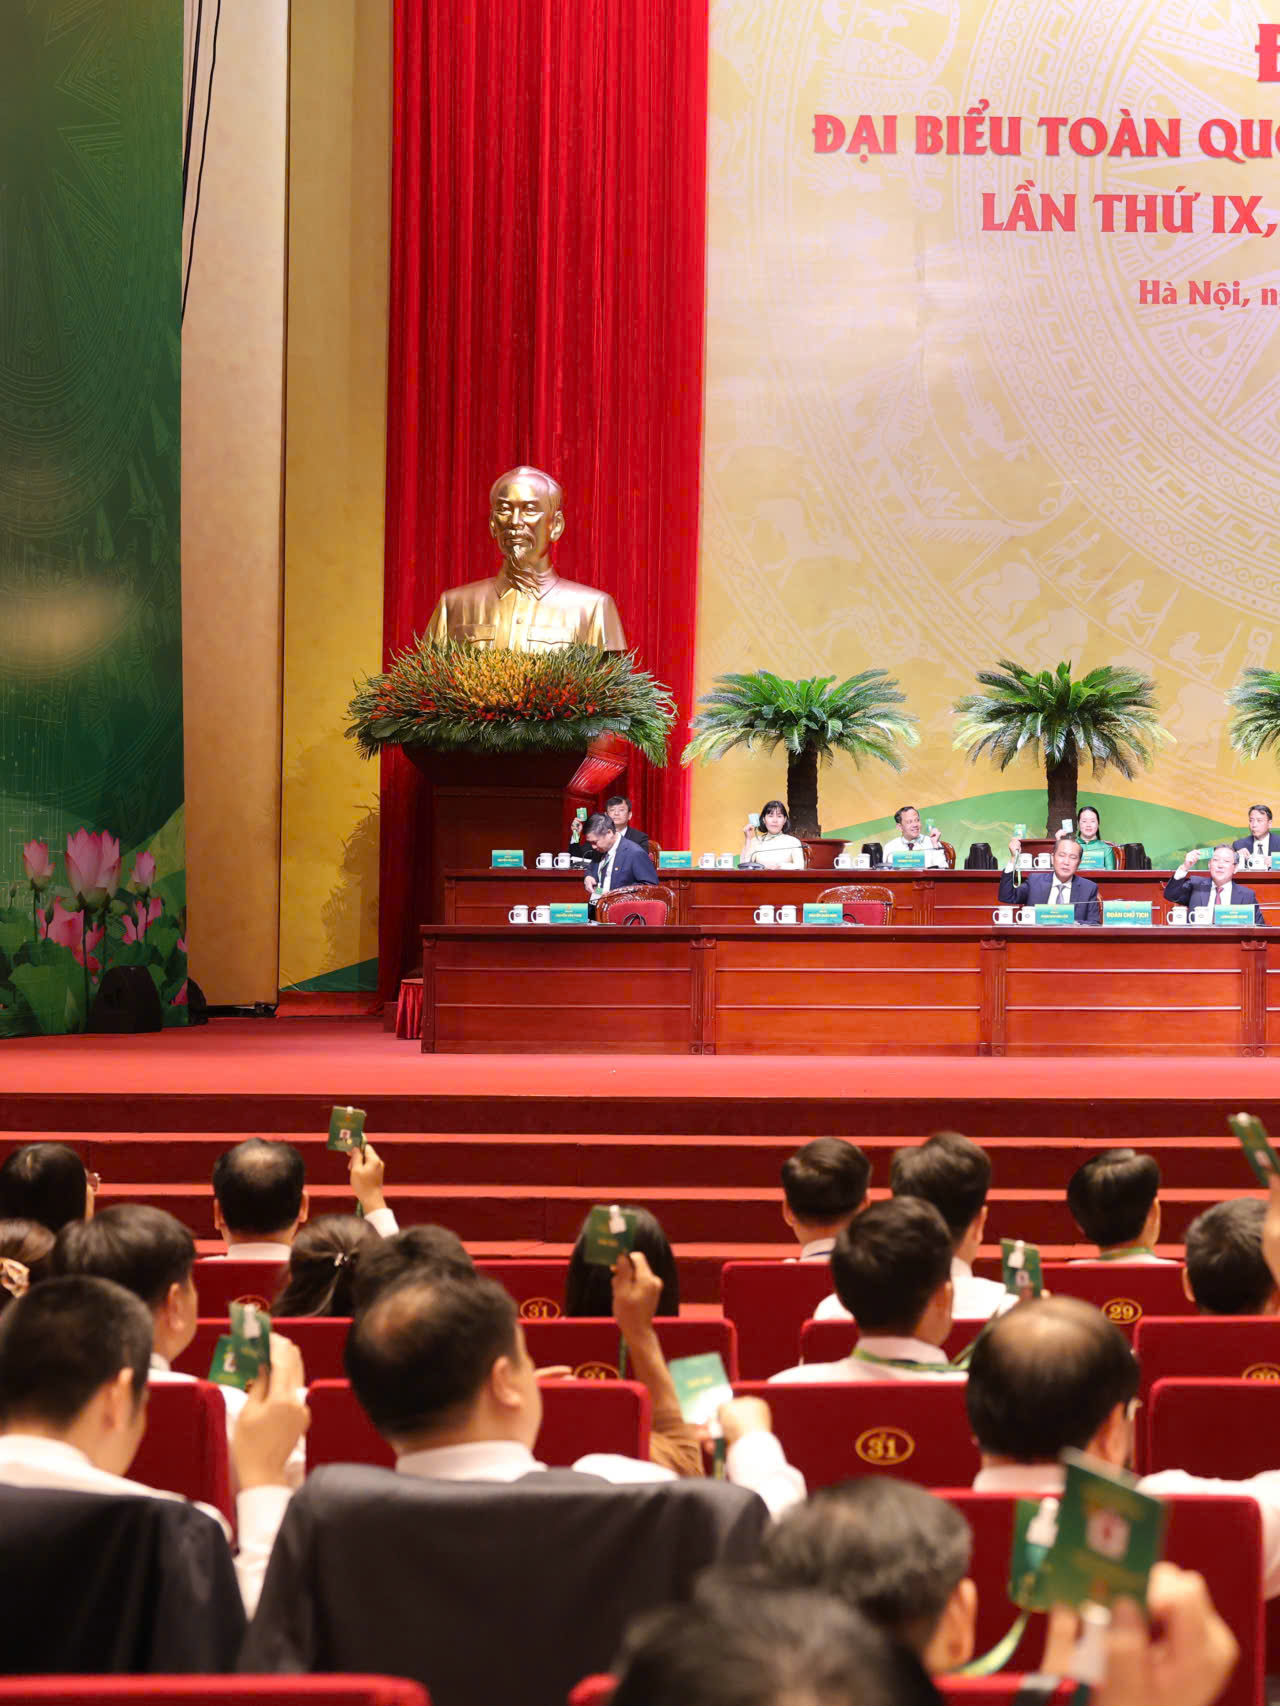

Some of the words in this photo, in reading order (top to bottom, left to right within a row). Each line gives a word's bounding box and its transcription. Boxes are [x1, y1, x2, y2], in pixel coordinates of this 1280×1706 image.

[812, 113, 898, 163] ĐẠI
[914, 98, 1023, 156] BIỂU
[1036, 109, 1182, 158] TOÀN
[981, 179, 1077, 232] LẦN
[1093, 185, 1202, 234] THỨ
[1213, 195, 1279, 239] IX,
[1139, 279, 1178, 305] Hà
[1188, 279, 1250, 310] Nội,
[1110, 1303, 1134, 1320] 29
[867, 1437, 897, 1458] 31
